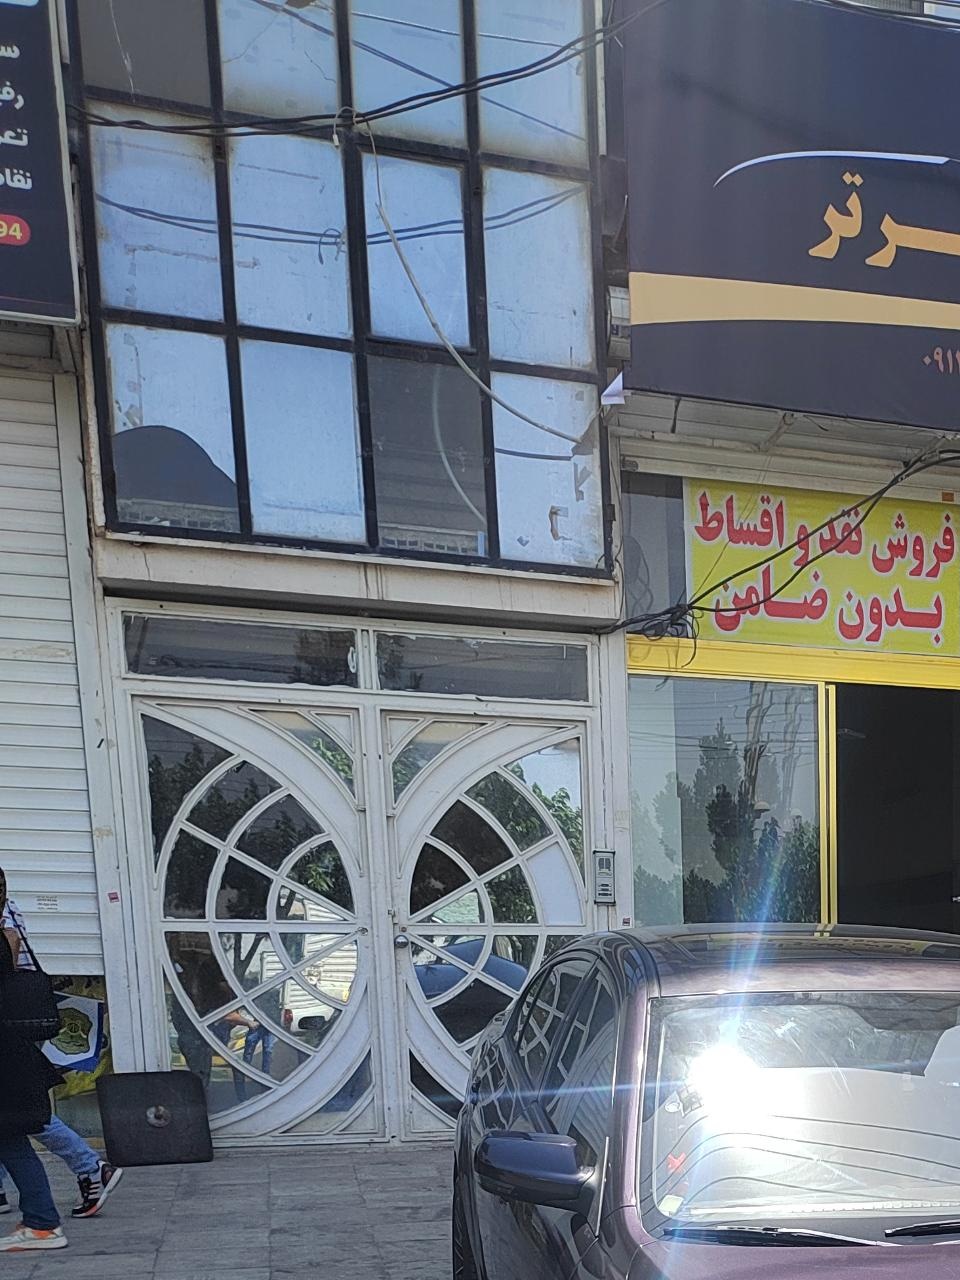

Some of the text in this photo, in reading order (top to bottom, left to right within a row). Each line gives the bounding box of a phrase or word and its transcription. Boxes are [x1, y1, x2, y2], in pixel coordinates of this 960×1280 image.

[694, 490, 956, 578] فروش نقد و اقساط
[713, 564, 944, 645] بدون ضامن
